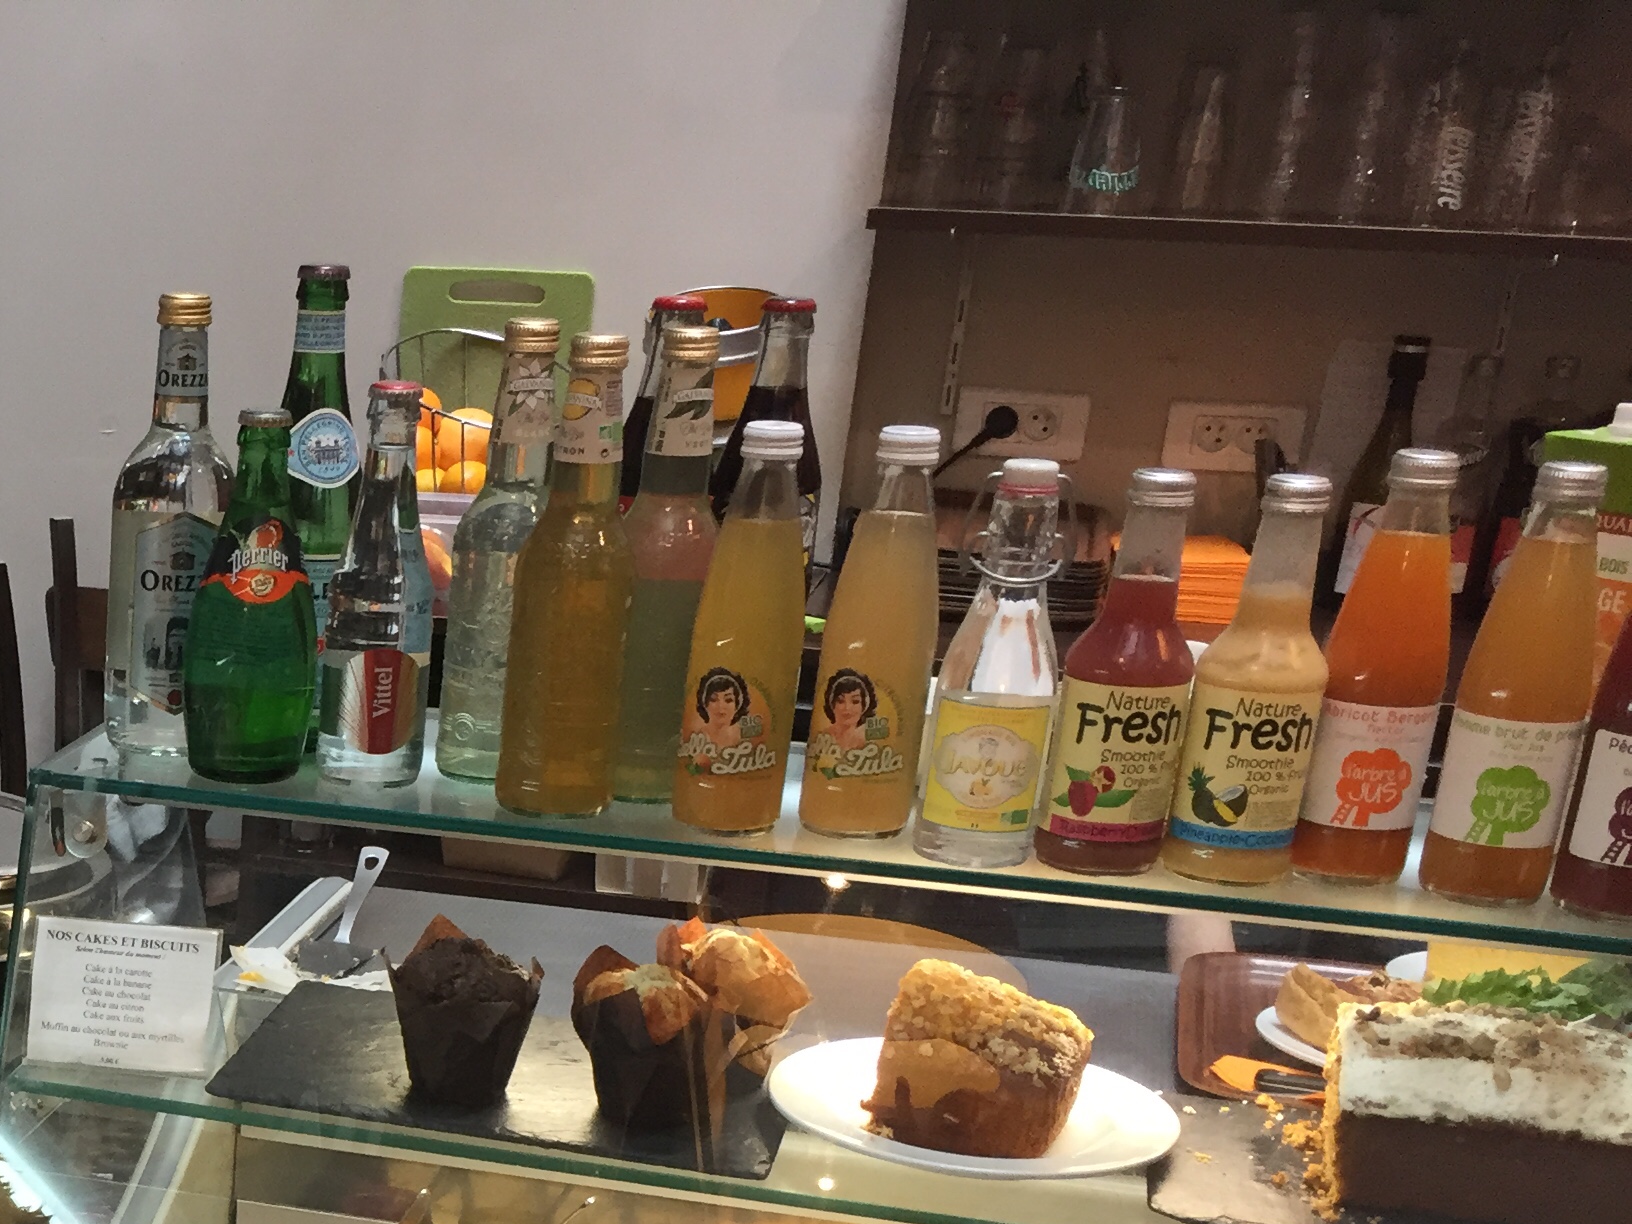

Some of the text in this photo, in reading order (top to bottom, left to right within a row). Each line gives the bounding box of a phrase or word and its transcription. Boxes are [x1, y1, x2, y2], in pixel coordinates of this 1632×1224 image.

[372, 666, 394, 719] Vittel
[1105, 690, 1172, 712] Nature
[1235, 697, 1303, 718] Nature
[1075, 701, 1183, 746] Fresh
[1203, 707, 1313, 753] Fresh
[1100, 748, 1166, 764] Smoothie
[1225, 754, 1295, 770] Smoothie
[1119, 763, 1145, 775] 100
[1244, 770, 1272, 783] 100
[46, 929, 200, 953] NOS CAKES ET BISCUITS
[84, 963, 105, 973] Cake
[83, 975, 104, 985] Cake
[81, 986, 102, 996] Cake
[116, 990, 150, 1001] chocolat
[85, 999, 106, 1008] Cake
[82, 1010, 104, 1020] Cake
[123, 1014, 144, 1024] fruits
[40, 1020, 69, 1032] Muffin
[82, 1025, 117, 1037] chocolat
[93, 1038, 128, 1049] Brownie
